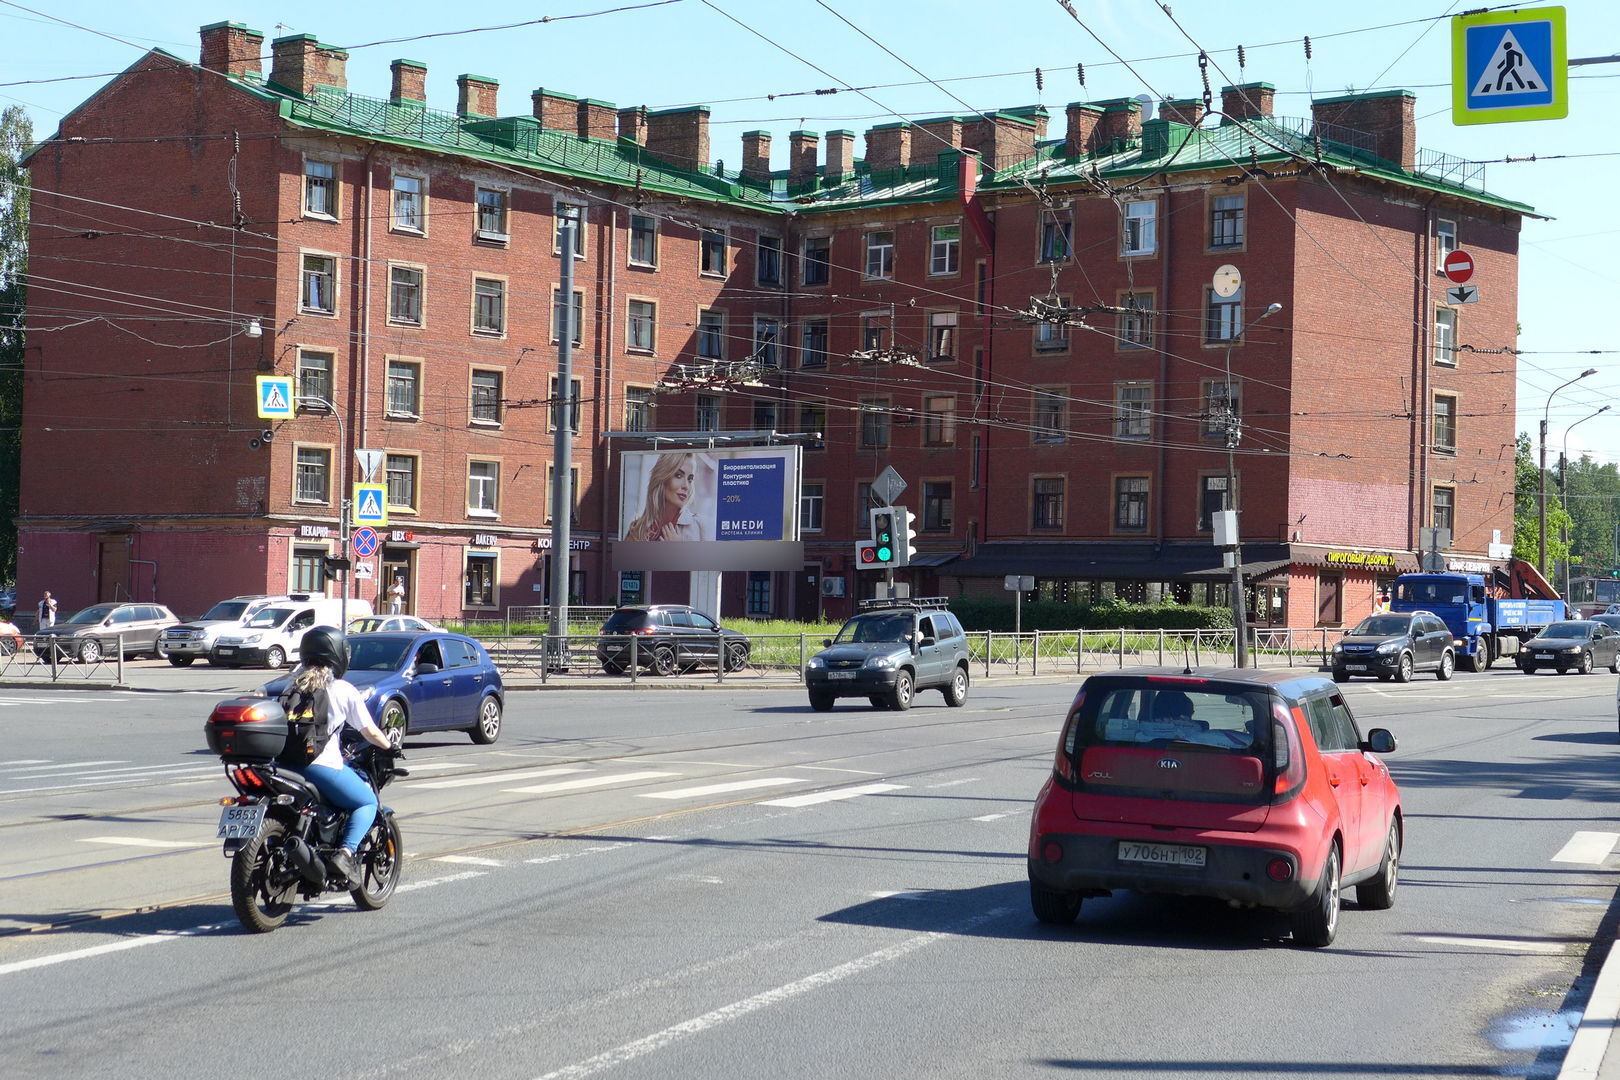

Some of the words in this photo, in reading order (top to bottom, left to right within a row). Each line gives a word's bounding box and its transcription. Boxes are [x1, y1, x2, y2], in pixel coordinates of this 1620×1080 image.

[723, 463, 777, 472] Биоревитализация
[301, 525, 329, 538] ПЕКАРНЯ
[392, 530, 406, 541] ЦЕХ
[475, 534, 498, 546] BAKERY
[1328, 551, 1365, 565] ПИРОГОВЫЙ
[1365, 554, 1389, 566] ДВОРИК
[1160, 760, 1178, 769] KIA
[227, 809, 258, 820] 5853
[241, 825, 257, 835] 78
